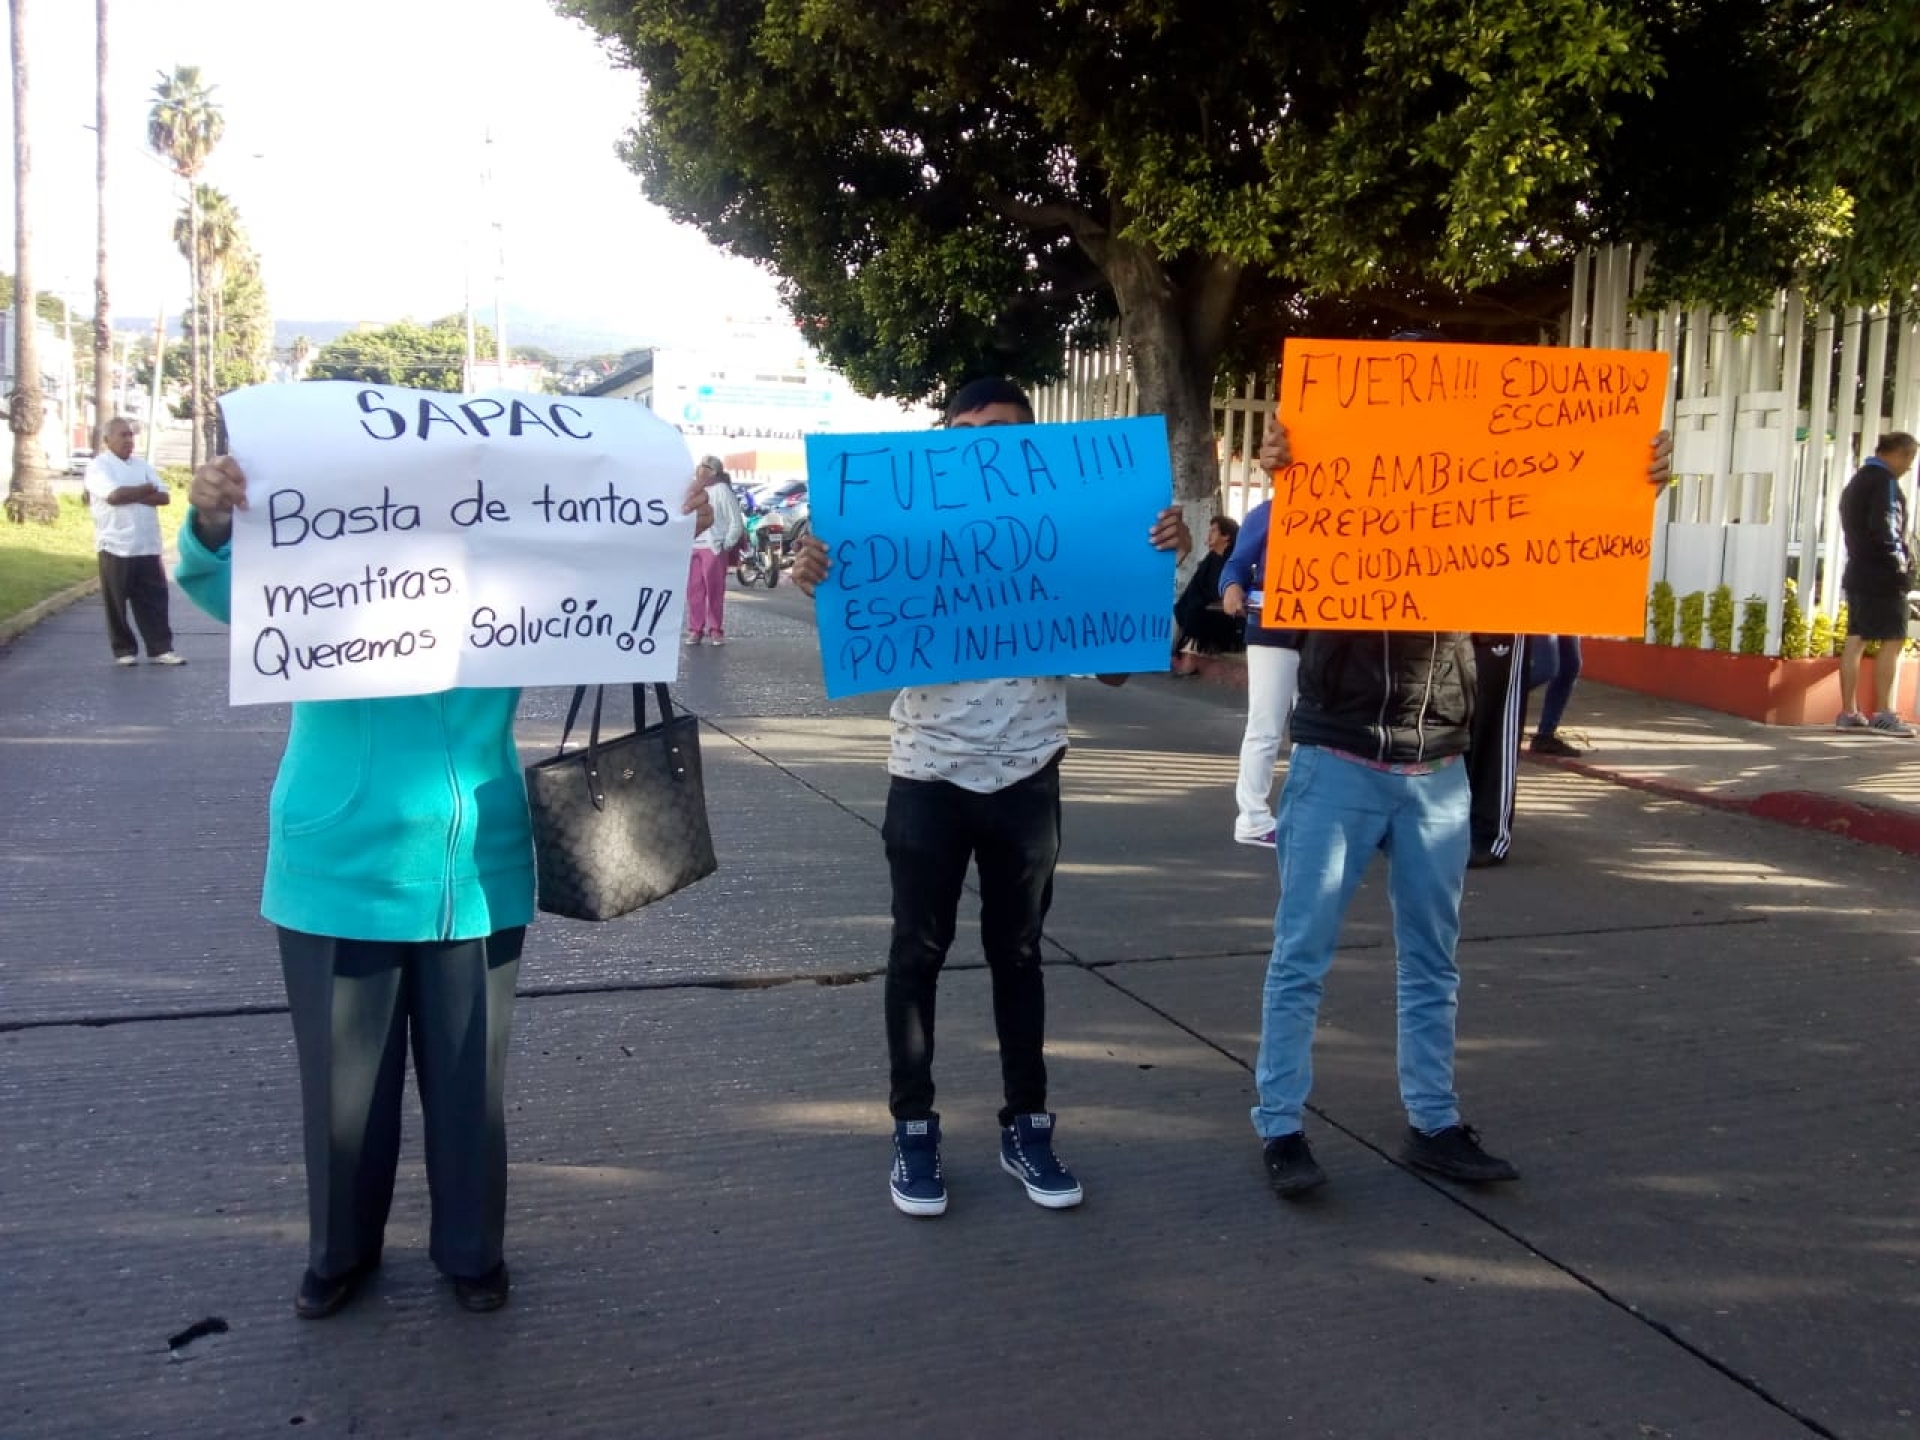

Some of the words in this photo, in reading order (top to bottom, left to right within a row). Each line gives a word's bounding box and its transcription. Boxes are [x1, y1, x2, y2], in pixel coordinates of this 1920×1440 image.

[1500, 356, 1650, 400] EDUARDO
[356, 389, 593, 440] SAPAC
[1284, 456, 1352, 505] POR
[269, 486, 421, 548] Basta
[450, 480, 510, 527] de
[533, 482, 670, 527] tantas
[836, 514, 1058, 592] EDUARDO
[1275, 553, 1319, 595] LOS
[264, 564, 453, 617] mentiras
[1275, 596, 1308, 623] LA
[1317, 589, 1428, 621] CULPA.
[253, 626, 437, 681] Queremos
[839, 624, 935, 681] POR
